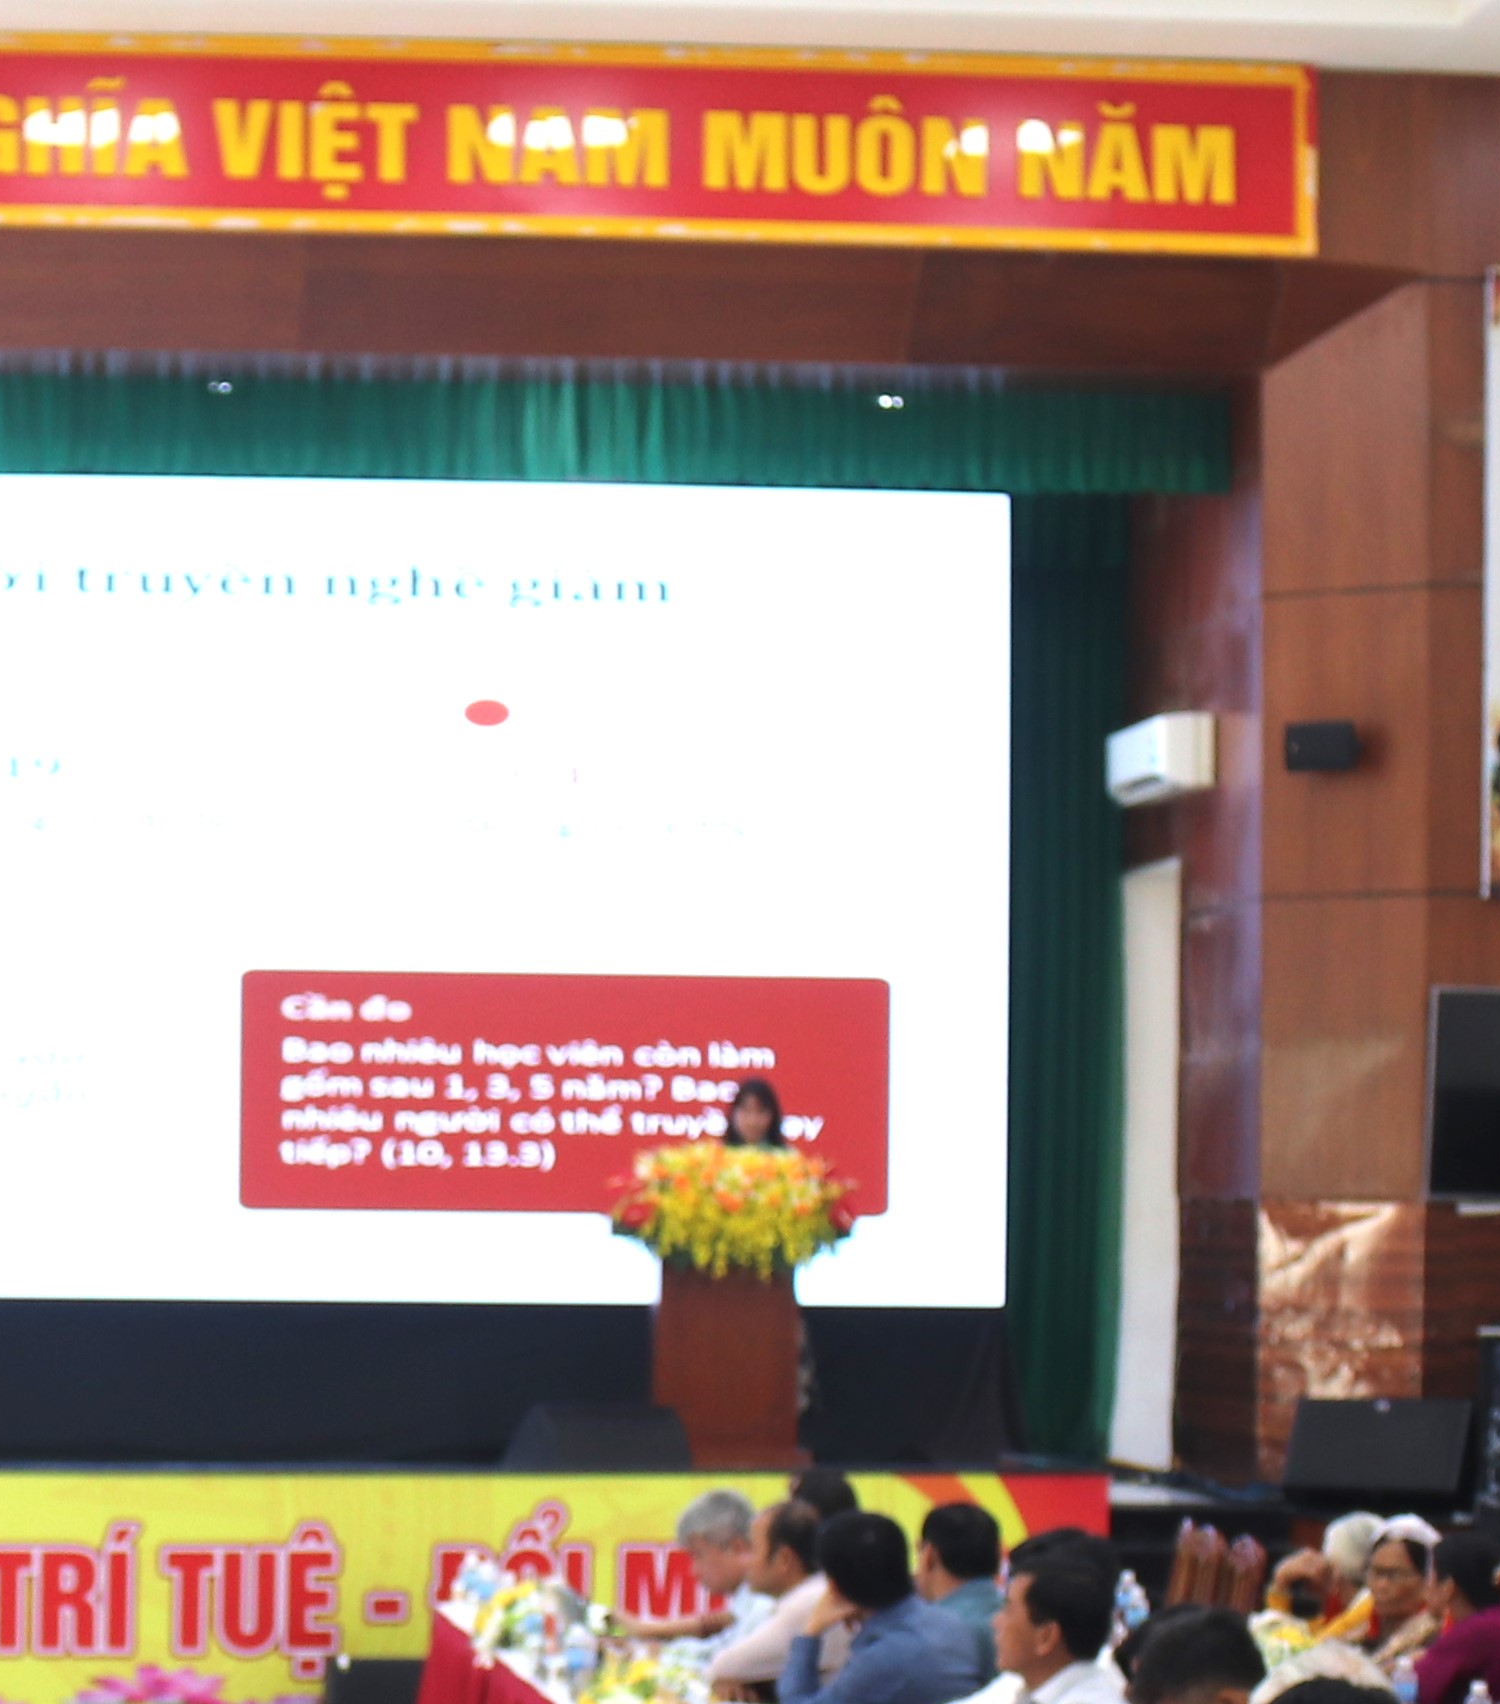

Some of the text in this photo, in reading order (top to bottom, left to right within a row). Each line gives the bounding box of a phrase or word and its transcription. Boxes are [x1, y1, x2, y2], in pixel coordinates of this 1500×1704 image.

[212, 82, 418, 198] VIỆT
[445, 102, 670, 190] NAM
[702, 94, 989, 199] MUÔN
[1017, 100, 1238, 206] NĂM
[161, 1520, 341, 1679] TUỆ
